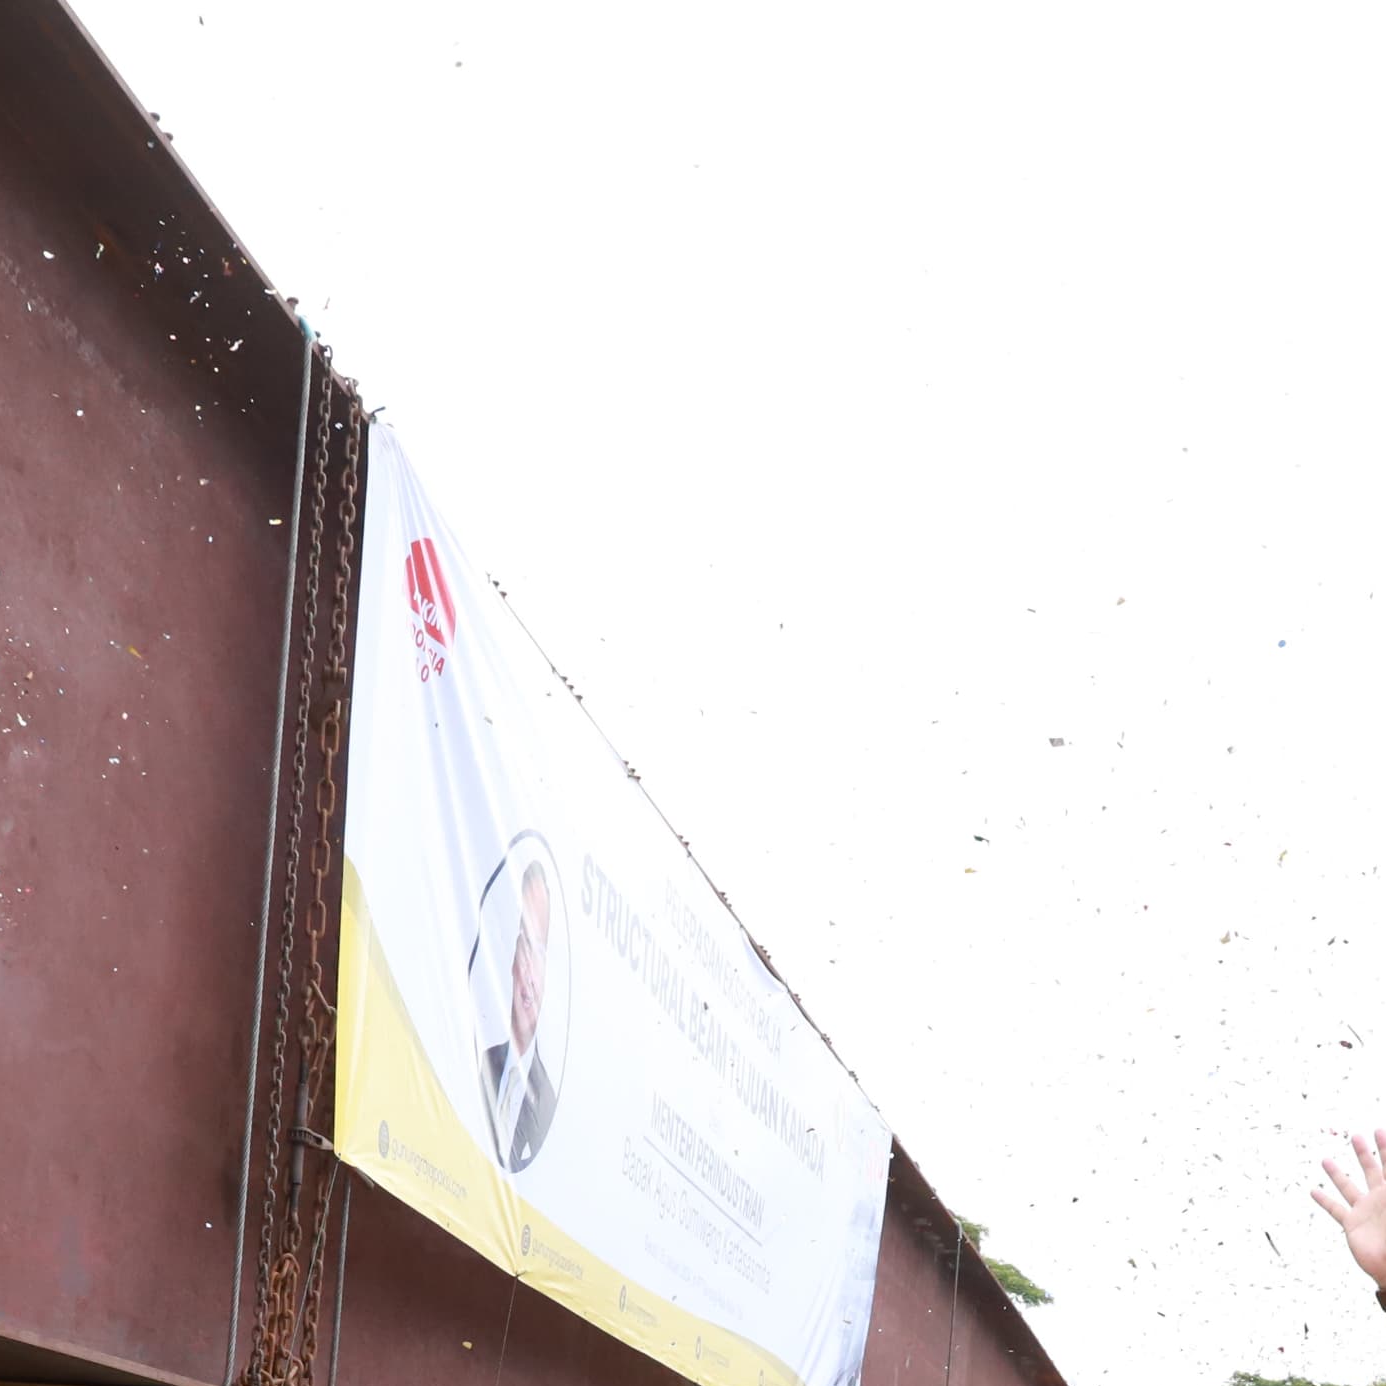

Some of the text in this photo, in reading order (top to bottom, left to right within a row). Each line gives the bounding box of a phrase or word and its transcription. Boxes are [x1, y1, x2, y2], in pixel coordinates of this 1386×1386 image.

[580, 851, 827, 1184] STRUCTURAL BEAM TUJUAN KANADA
[662, 875, 723, 983] PELEPASAN
[756, 1006, 782, 1063] BAJA
[621, 1135, 653, 1199] Bapak
[650, 1088, 766, 1232] MENTERI PERINDUSTRIAN
